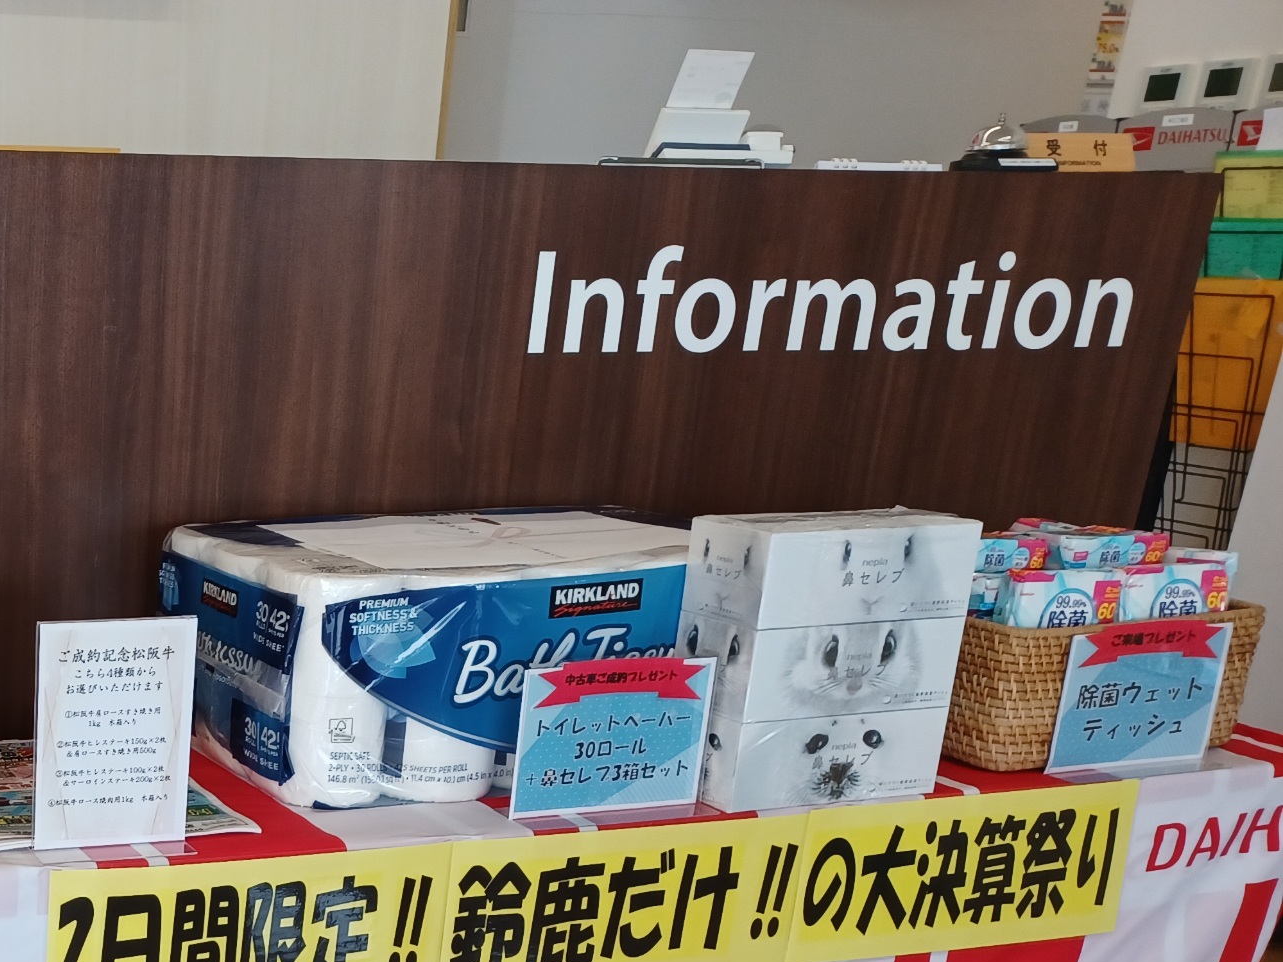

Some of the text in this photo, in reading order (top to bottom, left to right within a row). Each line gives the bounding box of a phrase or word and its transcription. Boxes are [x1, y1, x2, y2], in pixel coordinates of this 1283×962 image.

[1157, 128, 1228, 145] DAIHATSU
[527, 244, 1135, 354] Information
[862, 557, 888, 568] nepia
[983, 552, 1006, 568] 除菌
[1098, 550, 1121, 564] 除菌
[841, 567, 905, 588] 鼻セレブ
[203, 581, 238, 606] KIRKLAND
[554, 581, 640, 606] KIRKLAND
[359, 597, 409, 610] PREMIUM
[553, 600, 638, 618] Signature
[349, 609, 408, 623] SOFTNESS
[351, 621, 415, 636] THICKNESS
[1111, 629, 1197, 648] ご来場プレゼント
[58, 645, 176, 663] ご成約記念松阪牛
[74, 666, 157, 679] こちら4種類から
[565, 669, 678, 686] 中古車ご成約プレゼント
[66, 680, 164, 695] お選びいただけます
[1075, 676, 1204, 711] 除菌ウェット
[88, 719, 102, 728] 1kg
[244, 716, 257, 740] 30
[1082, 713, 1183, 742] ティッシュ
[573, 737, 647, 760] 30ロール
[831, 741, 857, 752] nepia
[330, 751, 371, 761] SEPTIC SAFE
[327, 774, 348, 783] 146.8
[466, 773, 480, 783] (4.5
[493, 770, 504, 779] 4.0
[328, 764, 350, 772] 2-PLY
[409, 765, 437, 774] SHEETS
[438, 764, 452, 773] PER
[452, 763, 468, 772] ROLL
[1146, 805, 1283, 872] DAIH
